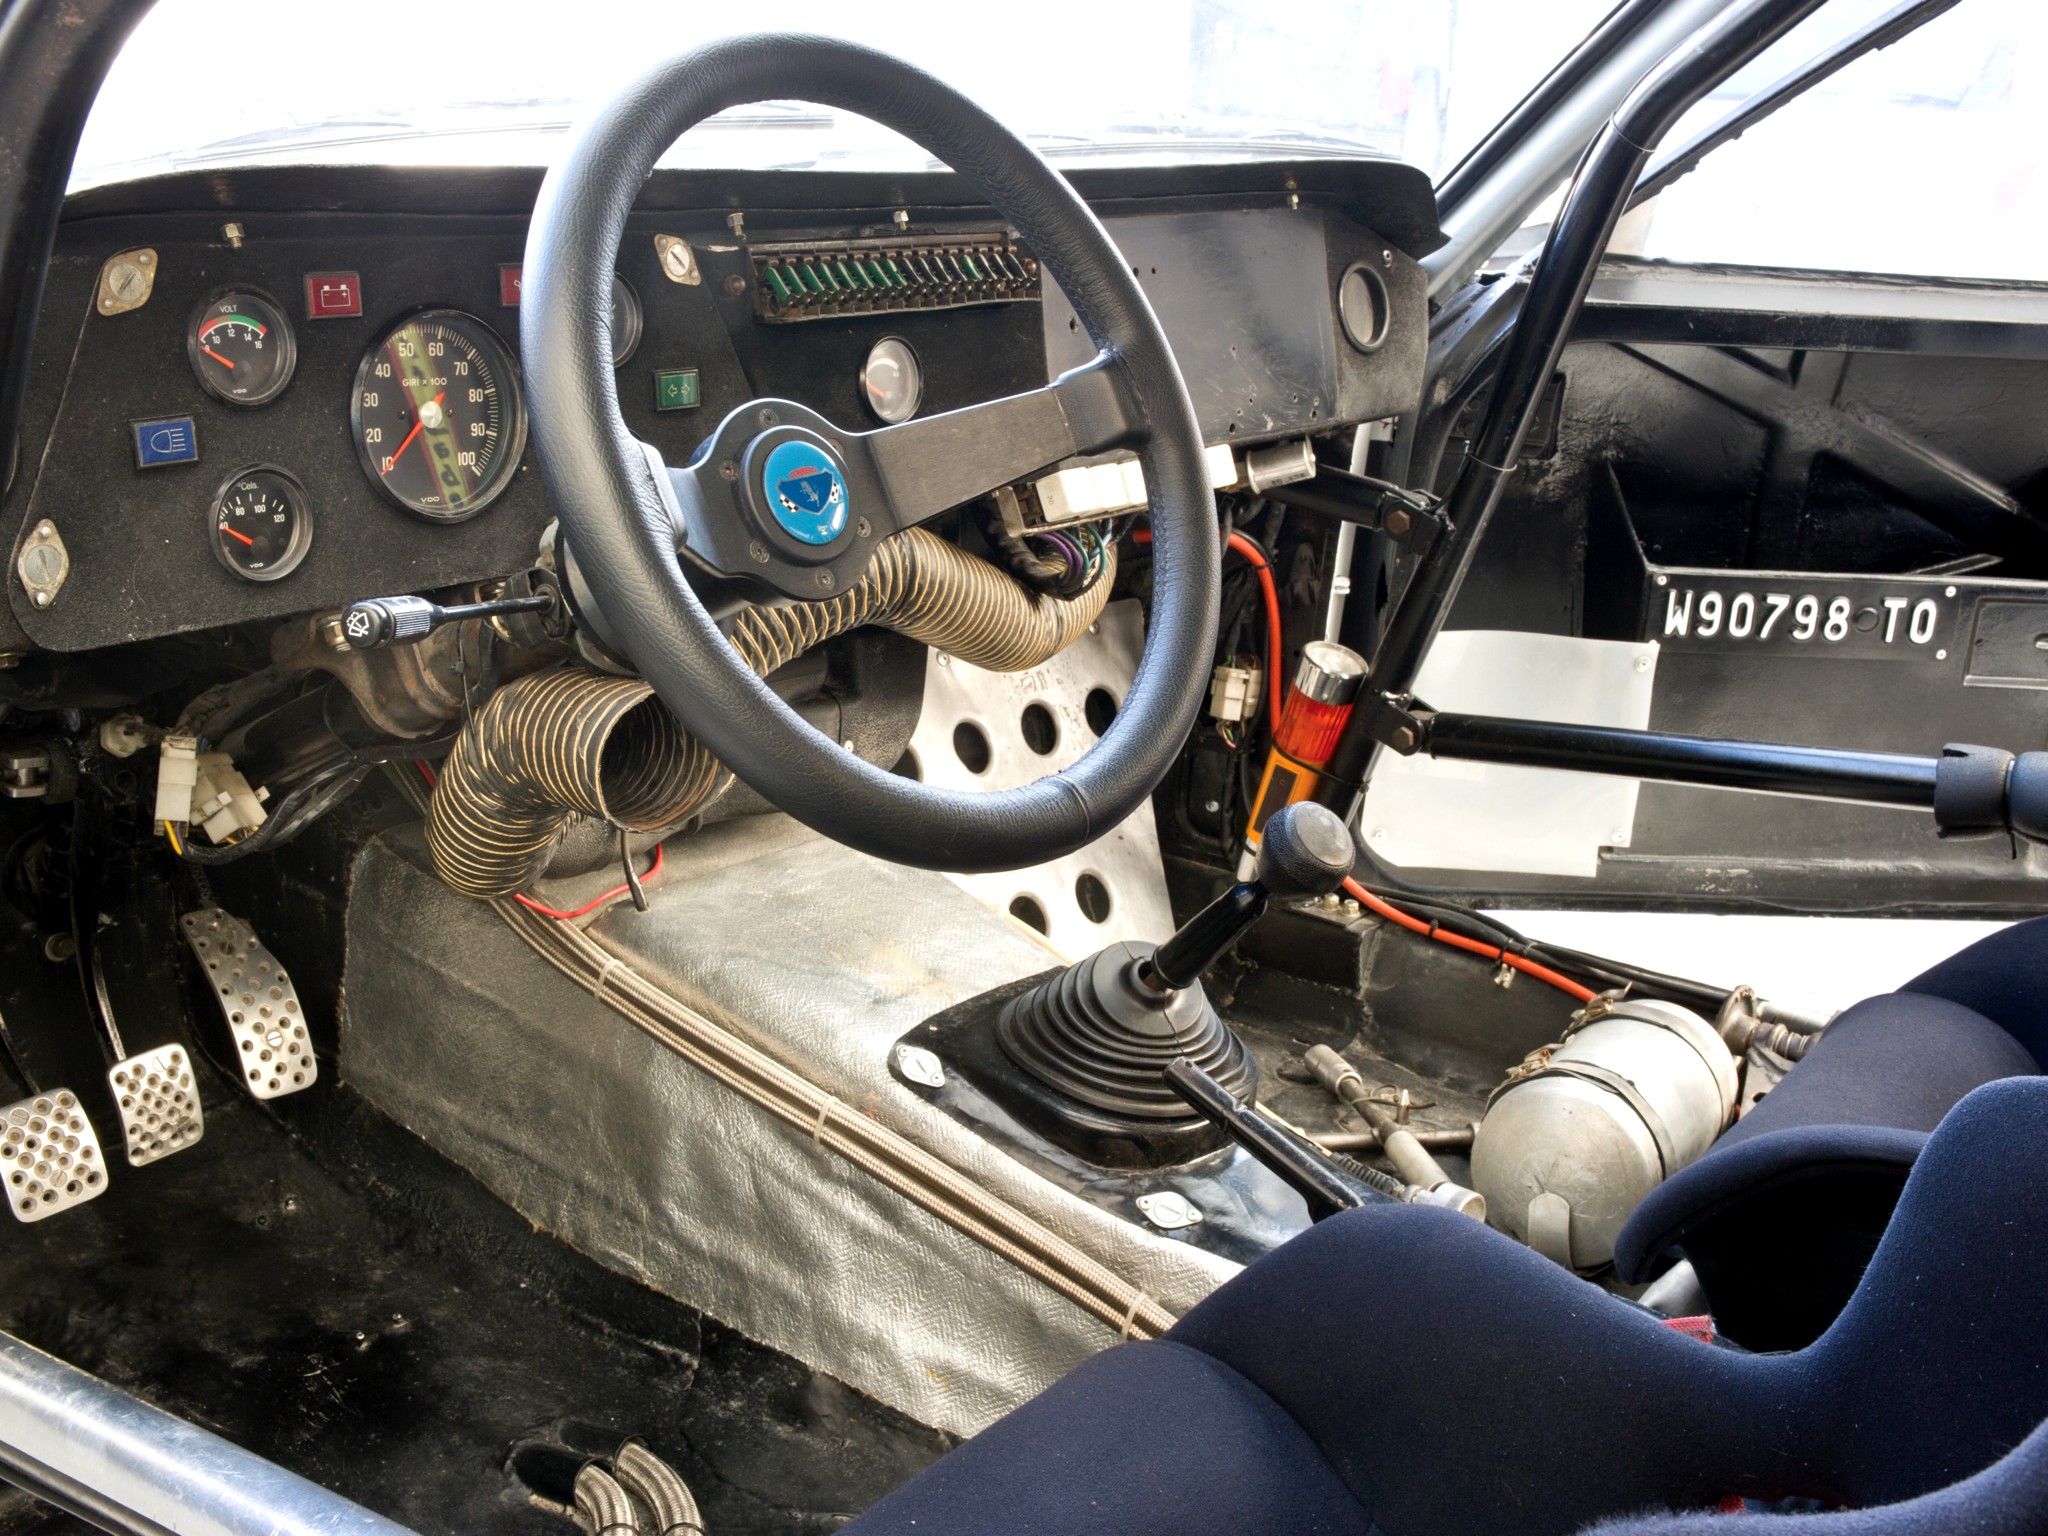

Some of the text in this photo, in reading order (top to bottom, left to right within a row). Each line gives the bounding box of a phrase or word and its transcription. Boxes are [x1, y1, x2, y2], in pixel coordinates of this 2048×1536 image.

[212, 336, 220, 344] 10
[228, 329, 235, 337] 12
[244, 333, 252, 341] 14
[255, 341, 262, 349] 16
[399, 343, 414, 357] 50
[429, 342, 444, 356] 60
[375, 363, 391, 378] 40
[454, 361, 468, 376] 70
[430, 377, 447, 385] 100
[364, 393, 378, 407] 30
[469, 389, 483, 403] 80
[367, 428, 382, 443] 20
[471, 423, 485, 437] 90
[382, 457, 394, 471] 10
[458, 452, 475, 466] 100
[236, 507, 245, 516] 80
[254, 505, 266, 513] 100
[274, 514, 285, 523] 120
[1664, 590, 1851, 642] W90798
